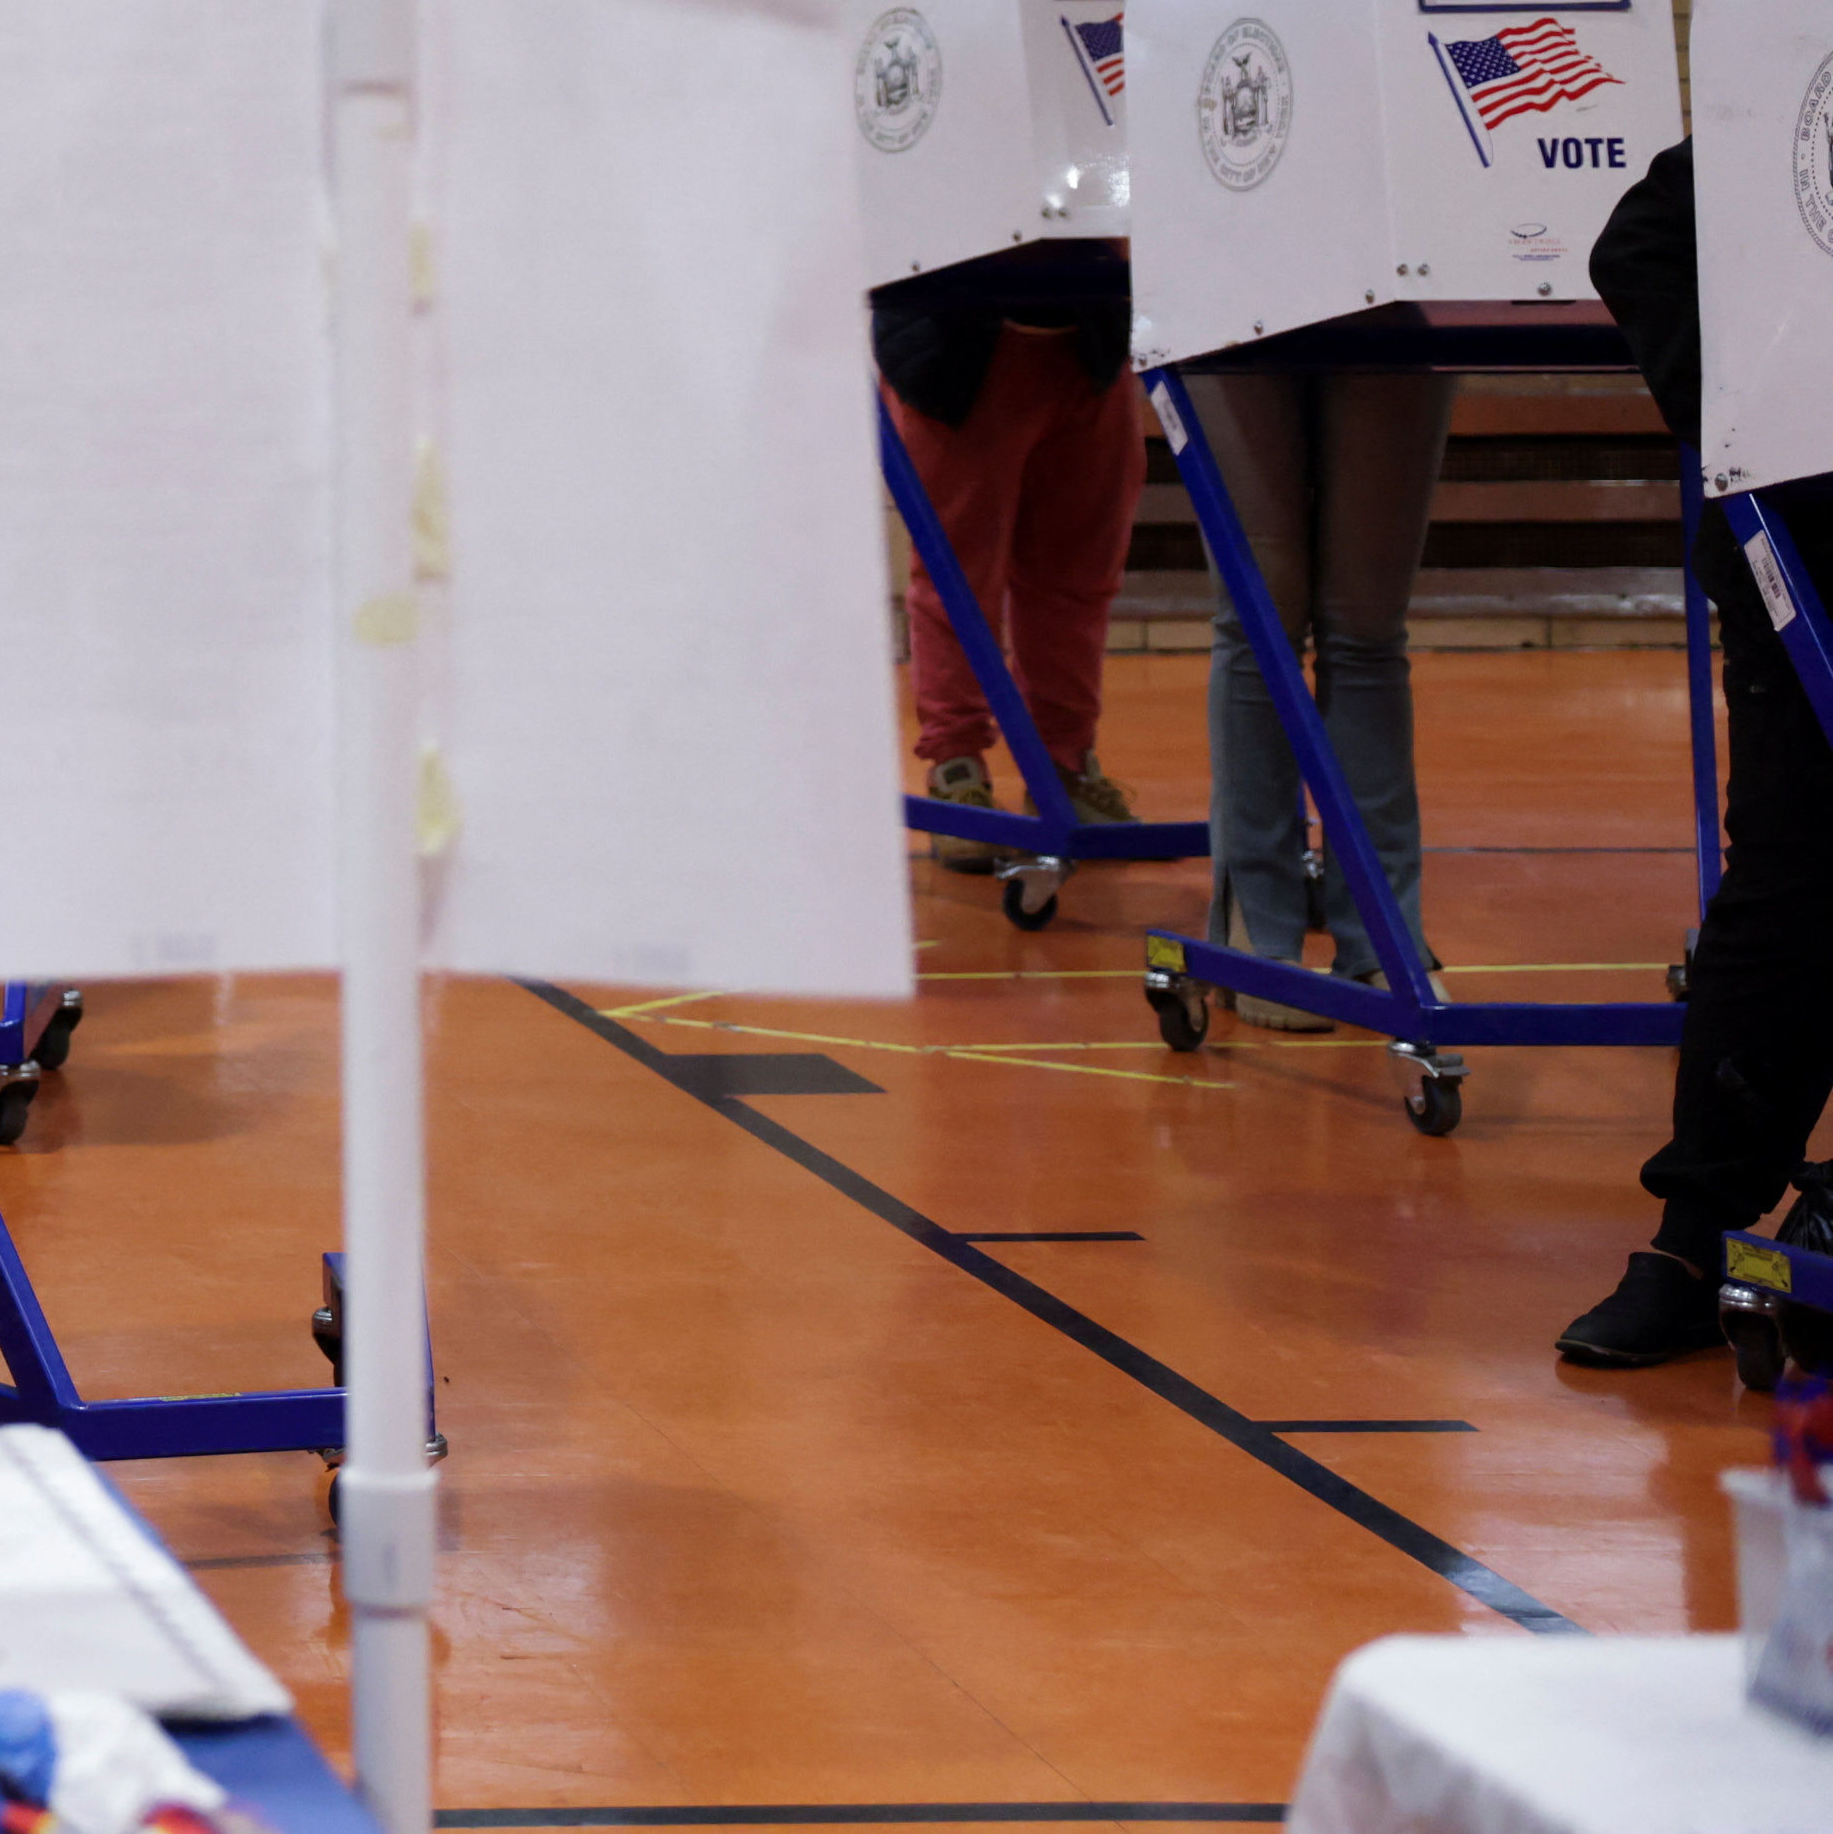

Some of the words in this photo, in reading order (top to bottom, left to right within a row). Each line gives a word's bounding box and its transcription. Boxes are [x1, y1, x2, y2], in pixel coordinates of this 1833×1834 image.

[1800, 70, 1833, 142] BOARD
[1536, 137, 1627, 169] VOTE
[1805, 193, 1828, 233] THE
